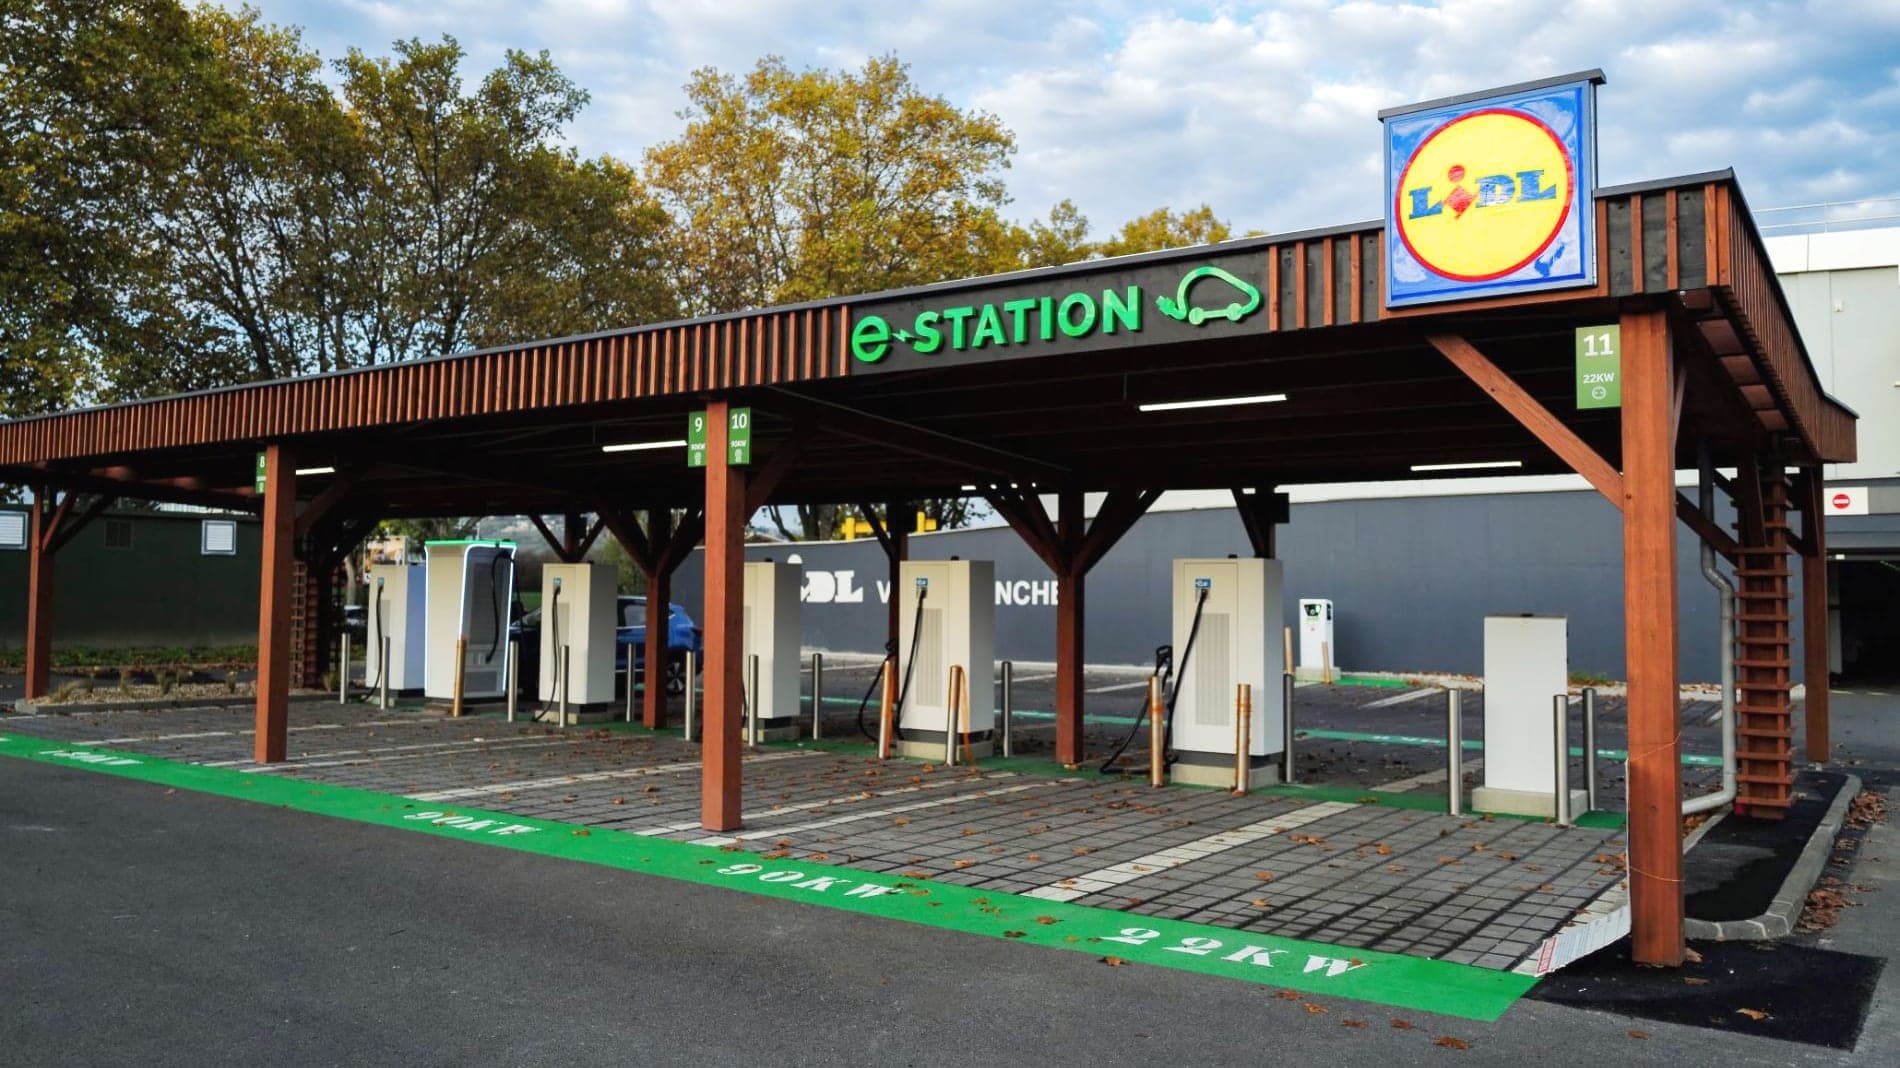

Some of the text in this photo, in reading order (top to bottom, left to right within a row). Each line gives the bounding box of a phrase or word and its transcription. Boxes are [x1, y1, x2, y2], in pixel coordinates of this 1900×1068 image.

[1583, 333, 1614, 357] 11
[1583, 372, 1615, 384] 22KW
[694, 416, 703, 433] 9
[731, 413, 748, 430] 10
[716, 864, 906, 898] 90KW
